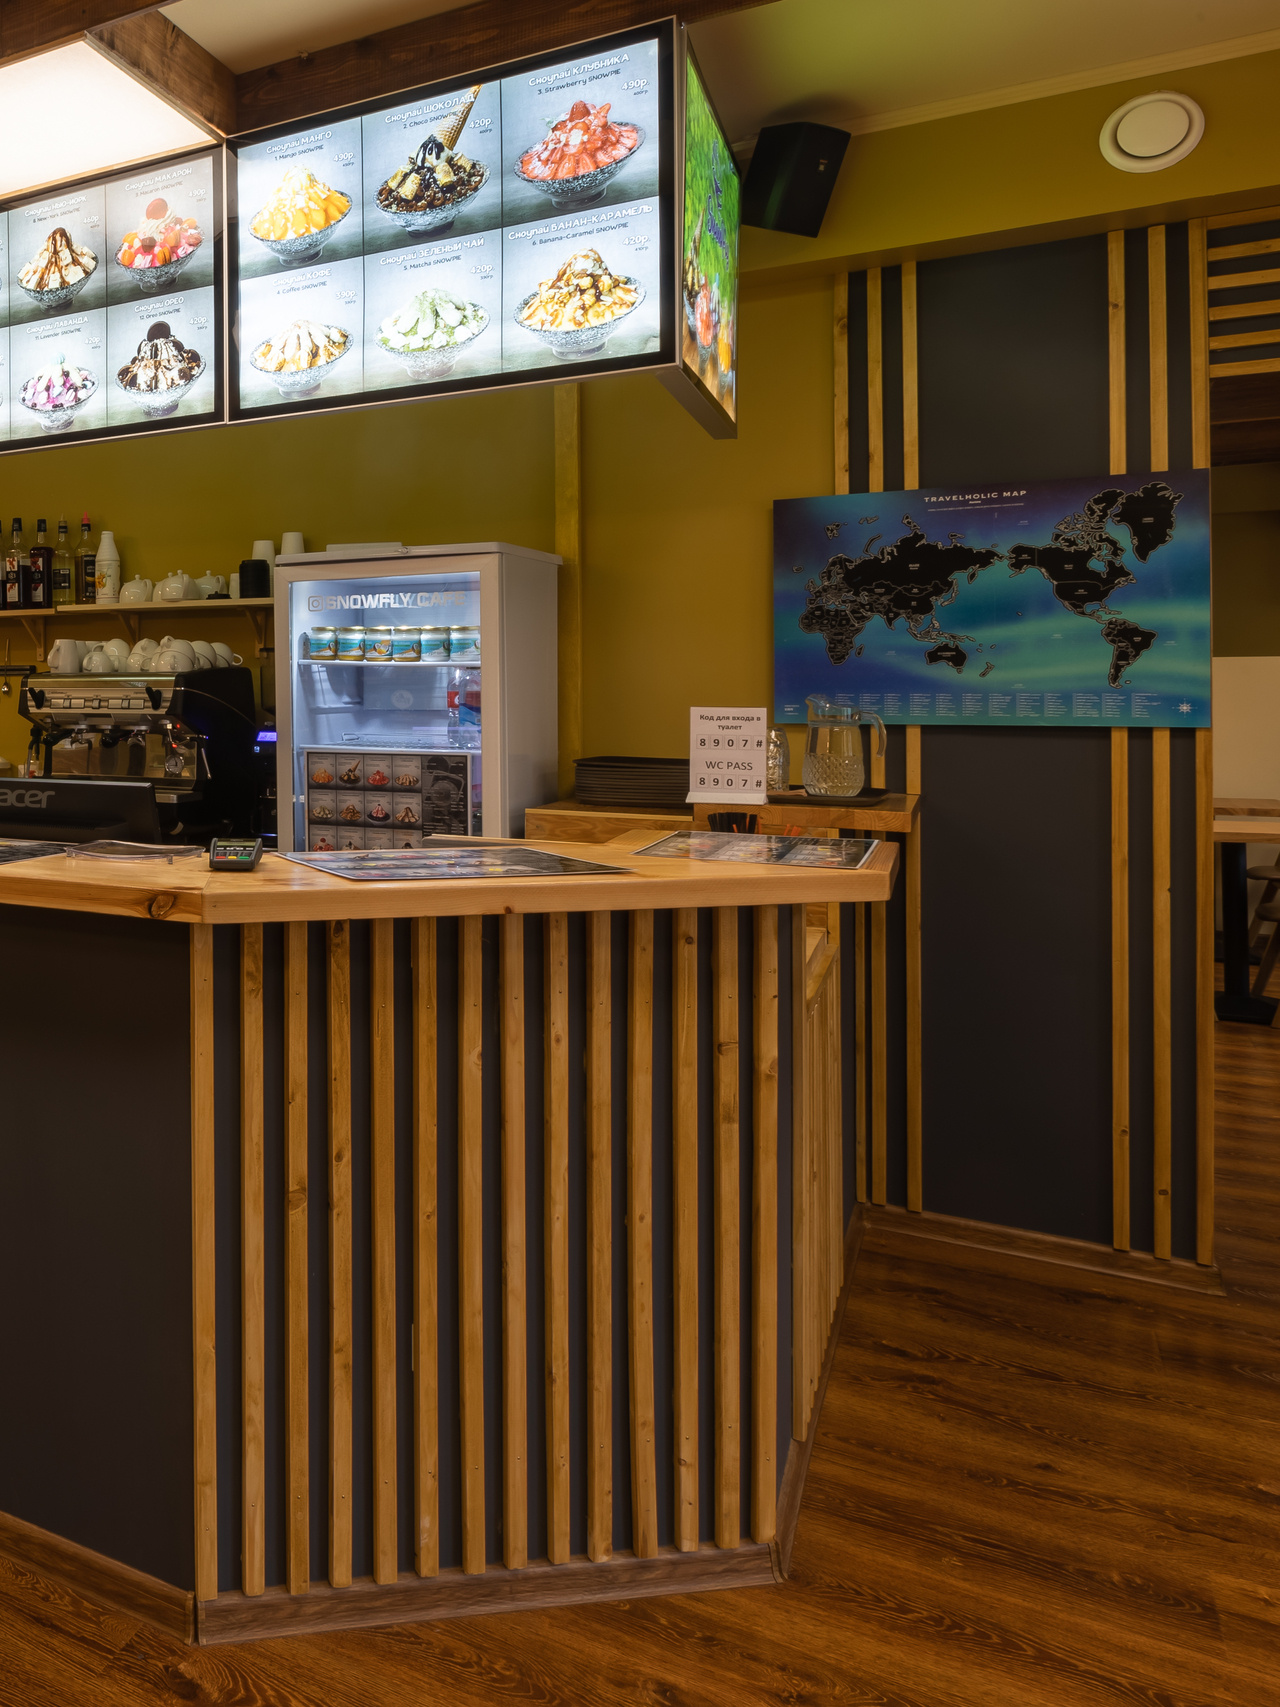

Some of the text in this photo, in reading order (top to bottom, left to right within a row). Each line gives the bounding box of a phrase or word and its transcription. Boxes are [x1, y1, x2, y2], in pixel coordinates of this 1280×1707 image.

[529, 54, 629, 86] Сноупай КЛУБНИКА
[545, 79, 586, 93] Strawberry
[588, 69, 620, 82] SNOWPIE
[385, 94, 474, 123] Сноупай ШОКОЛАД
[409, 120, 428, 128] Choco
[267, 131, 331, 154] Сноупай МАНГО
[279, 145, 323, 160] Mango SNOWPIE
[155, 168, 192, 183] МАКАРОН
[508, 205, 652, 240] Сноупай БАНАН-КАРАМЕЛЬ
[539, 222, 628, 244] Banana-Caramel SNOWPIE
[380, 236, 484, 265] Сноупай ЗЕЛЕНЫЙ ЧАЙ
[410, 255, 461, 269] Matcha SNOWPIE
[306, 269, 331, 279] КОФЕ
[283, 281, 327, 294] Coffee SNOWPIE
[165, 297, 184, 306] ОРЕО
[54, 317, 88, 328] ЛАВАНДА
[924, 492, 998, 502] TRAVELHOLIC
[326, 591, 465, 609] SNOWFLY CAFE
[705, 761, 753, 770] WC PASS
